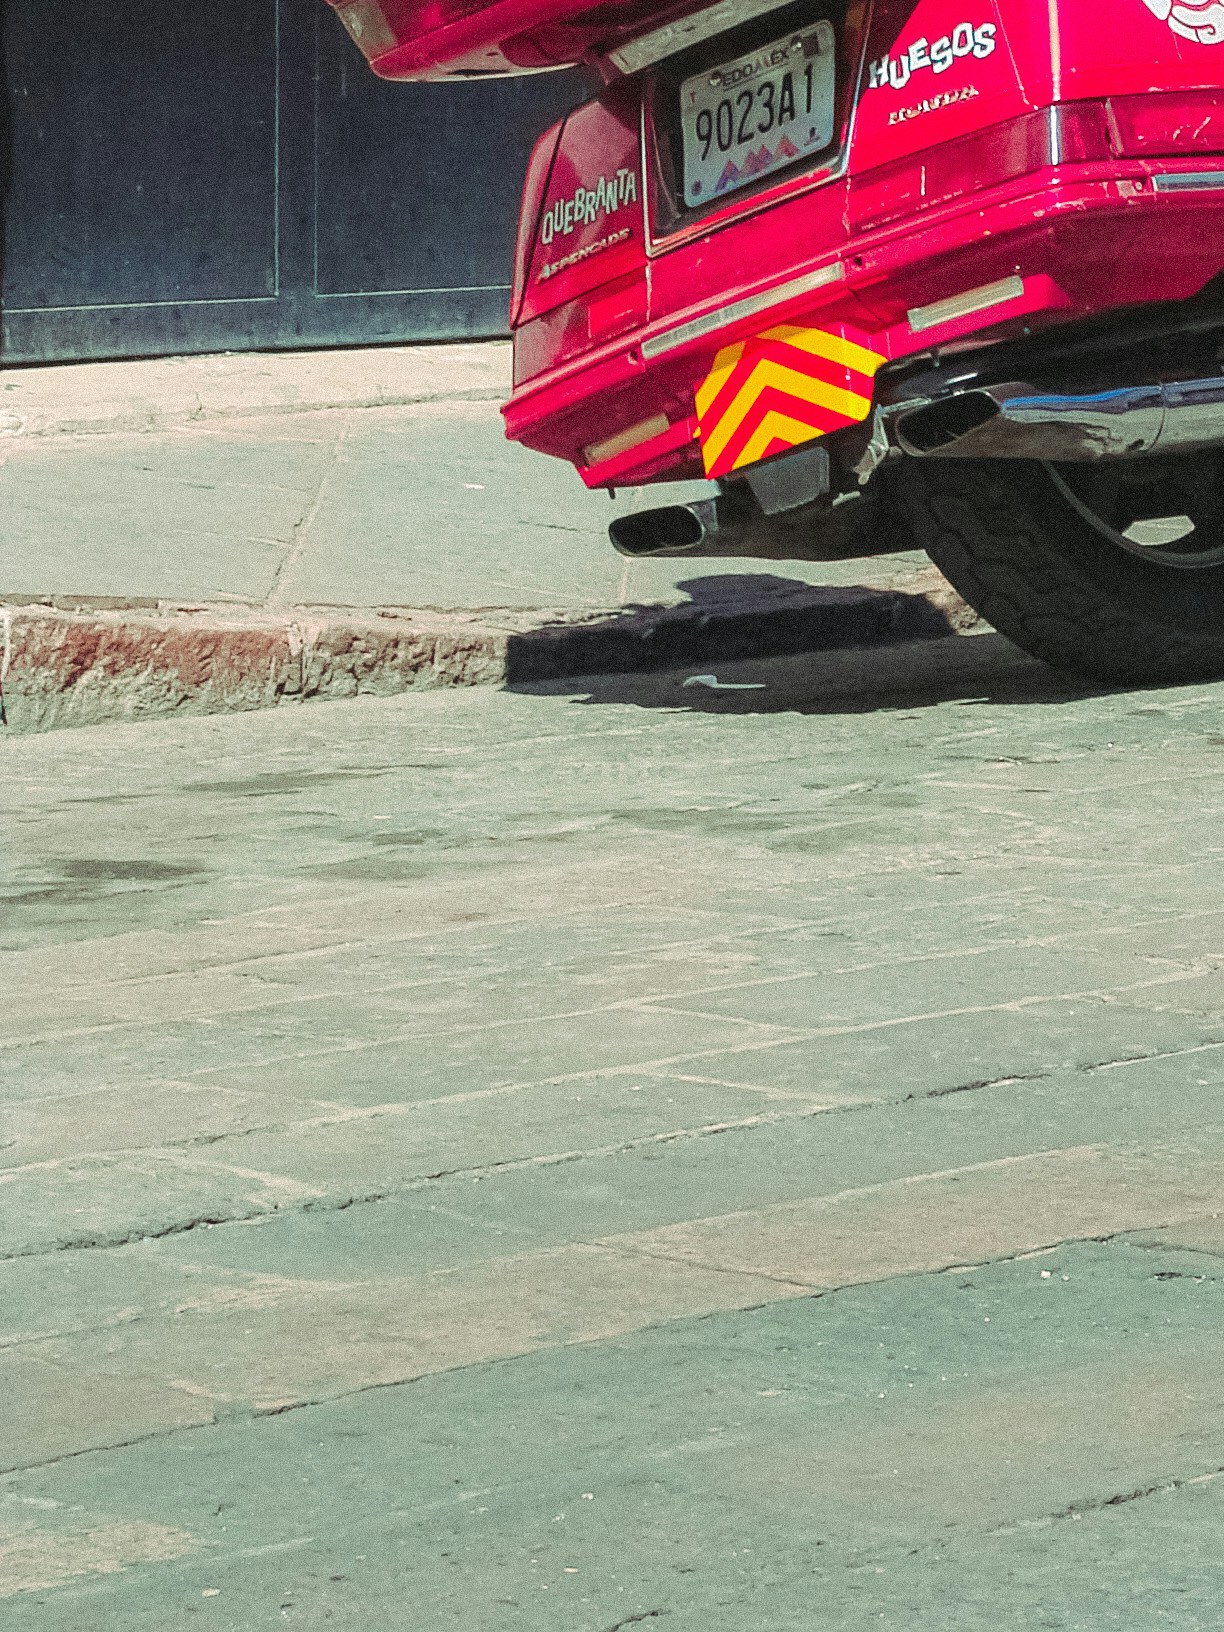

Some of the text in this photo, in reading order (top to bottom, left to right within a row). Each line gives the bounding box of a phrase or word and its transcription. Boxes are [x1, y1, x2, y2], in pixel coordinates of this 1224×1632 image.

[869, 21, 997, 90] HUESOS
[696, 63, 813, 161] 9023A1
[541, 167, 637, 245] QUEBRANTA
